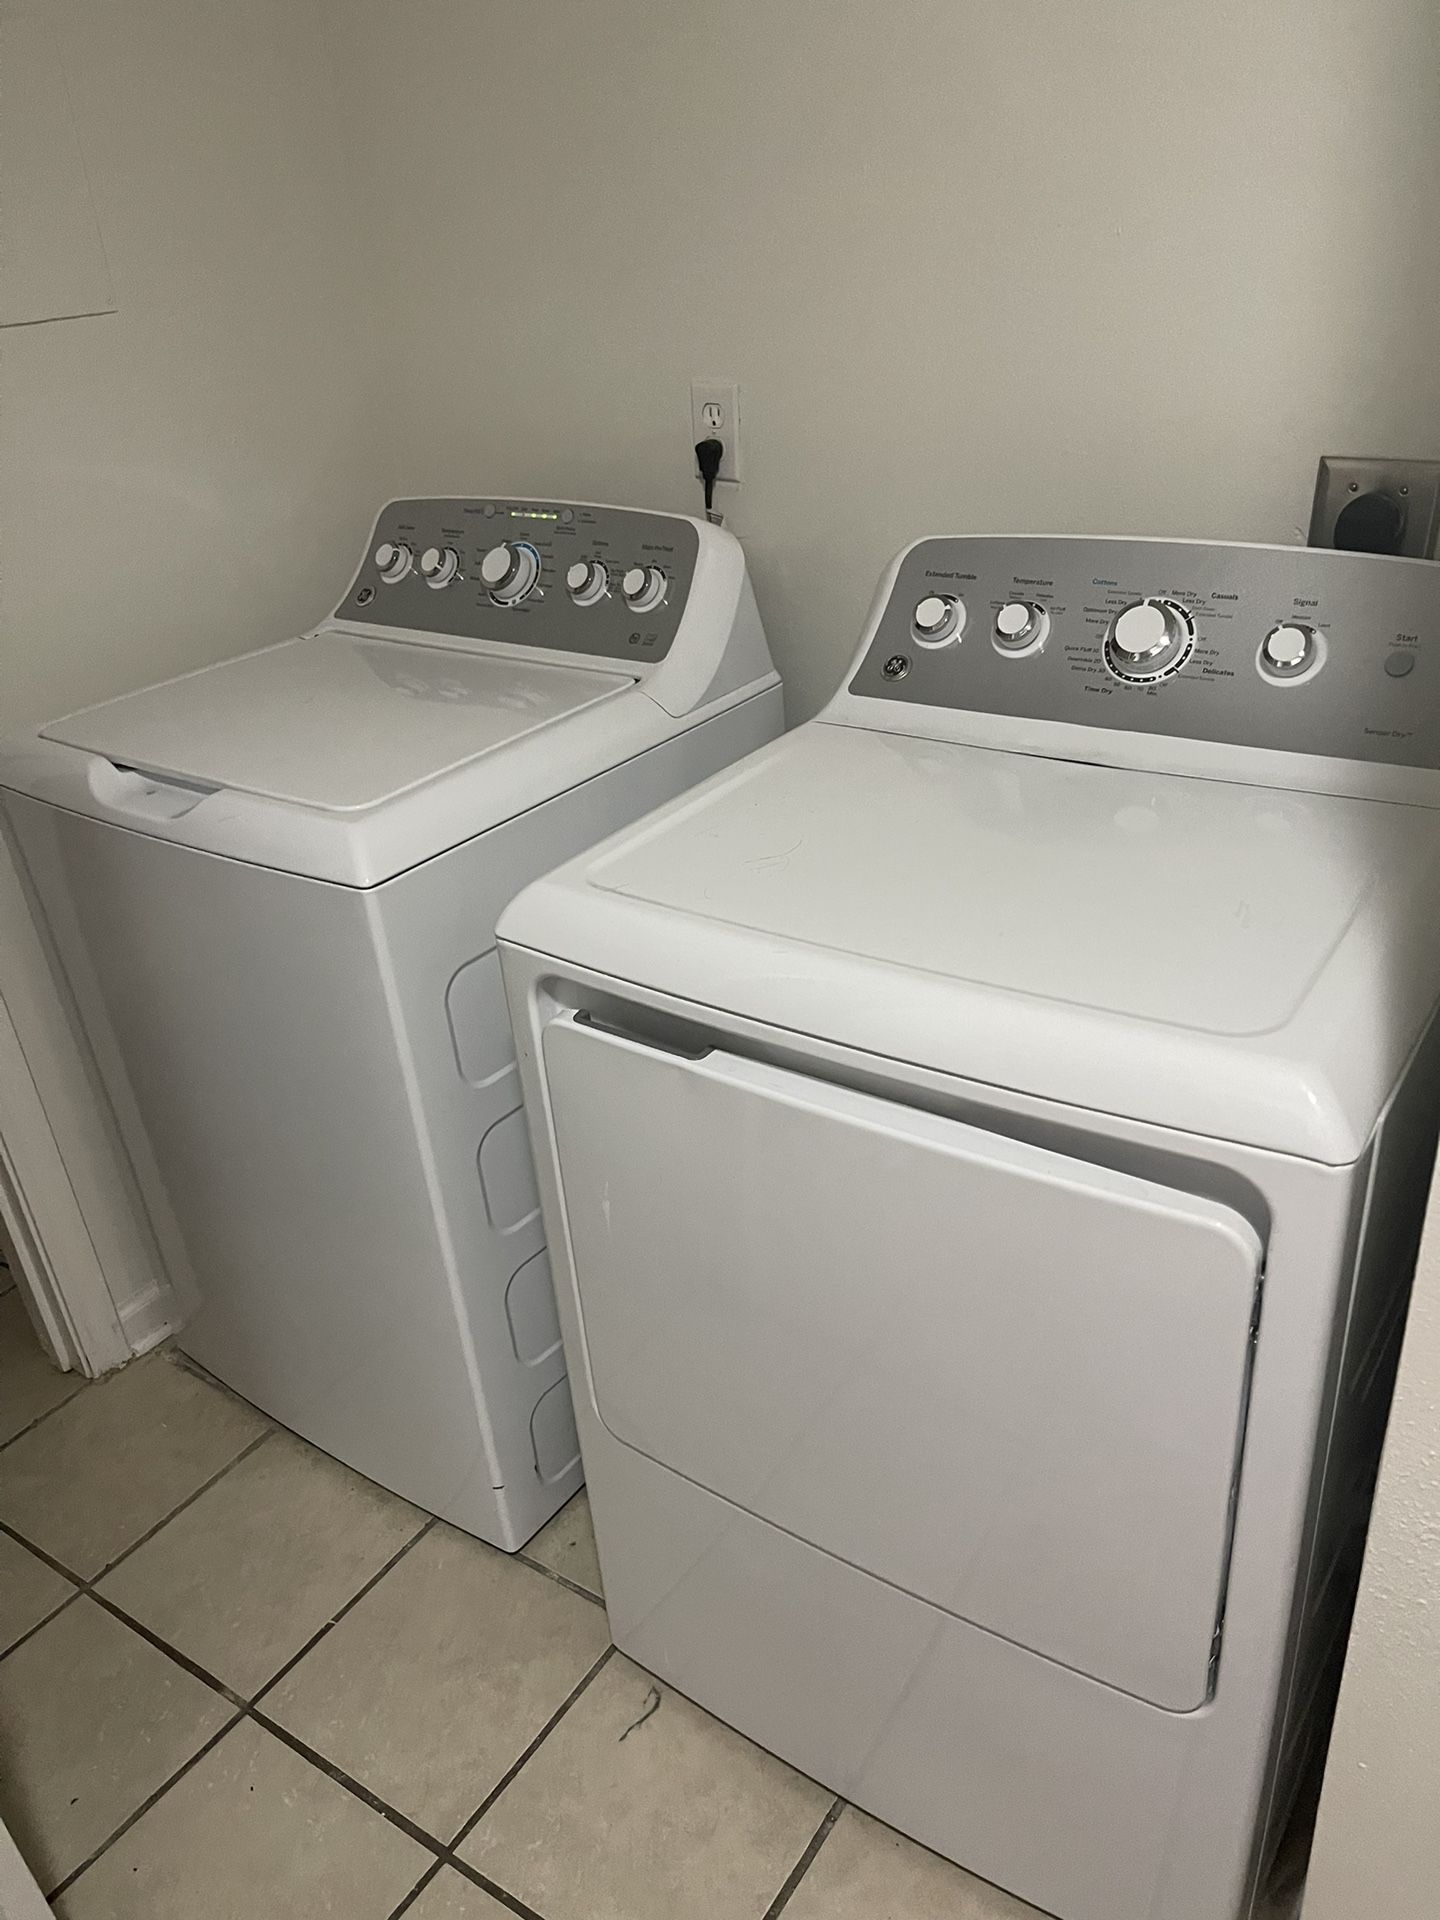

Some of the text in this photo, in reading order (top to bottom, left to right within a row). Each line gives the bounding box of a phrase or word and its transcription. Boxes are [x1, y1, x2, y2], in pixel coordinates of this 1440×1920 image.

[925, 570, 977, 580] Extended Tumble
[1013, 576, 1054, 586] Temperature
[1211, 592, 1239, 601] Casuals
[1293, 598, 1319, 607] Signal
[1396, 633, 1419, 642] Start
[1202, 667, 1235, 677] Delicates
[1101, 686, 1113, 696] Dry
